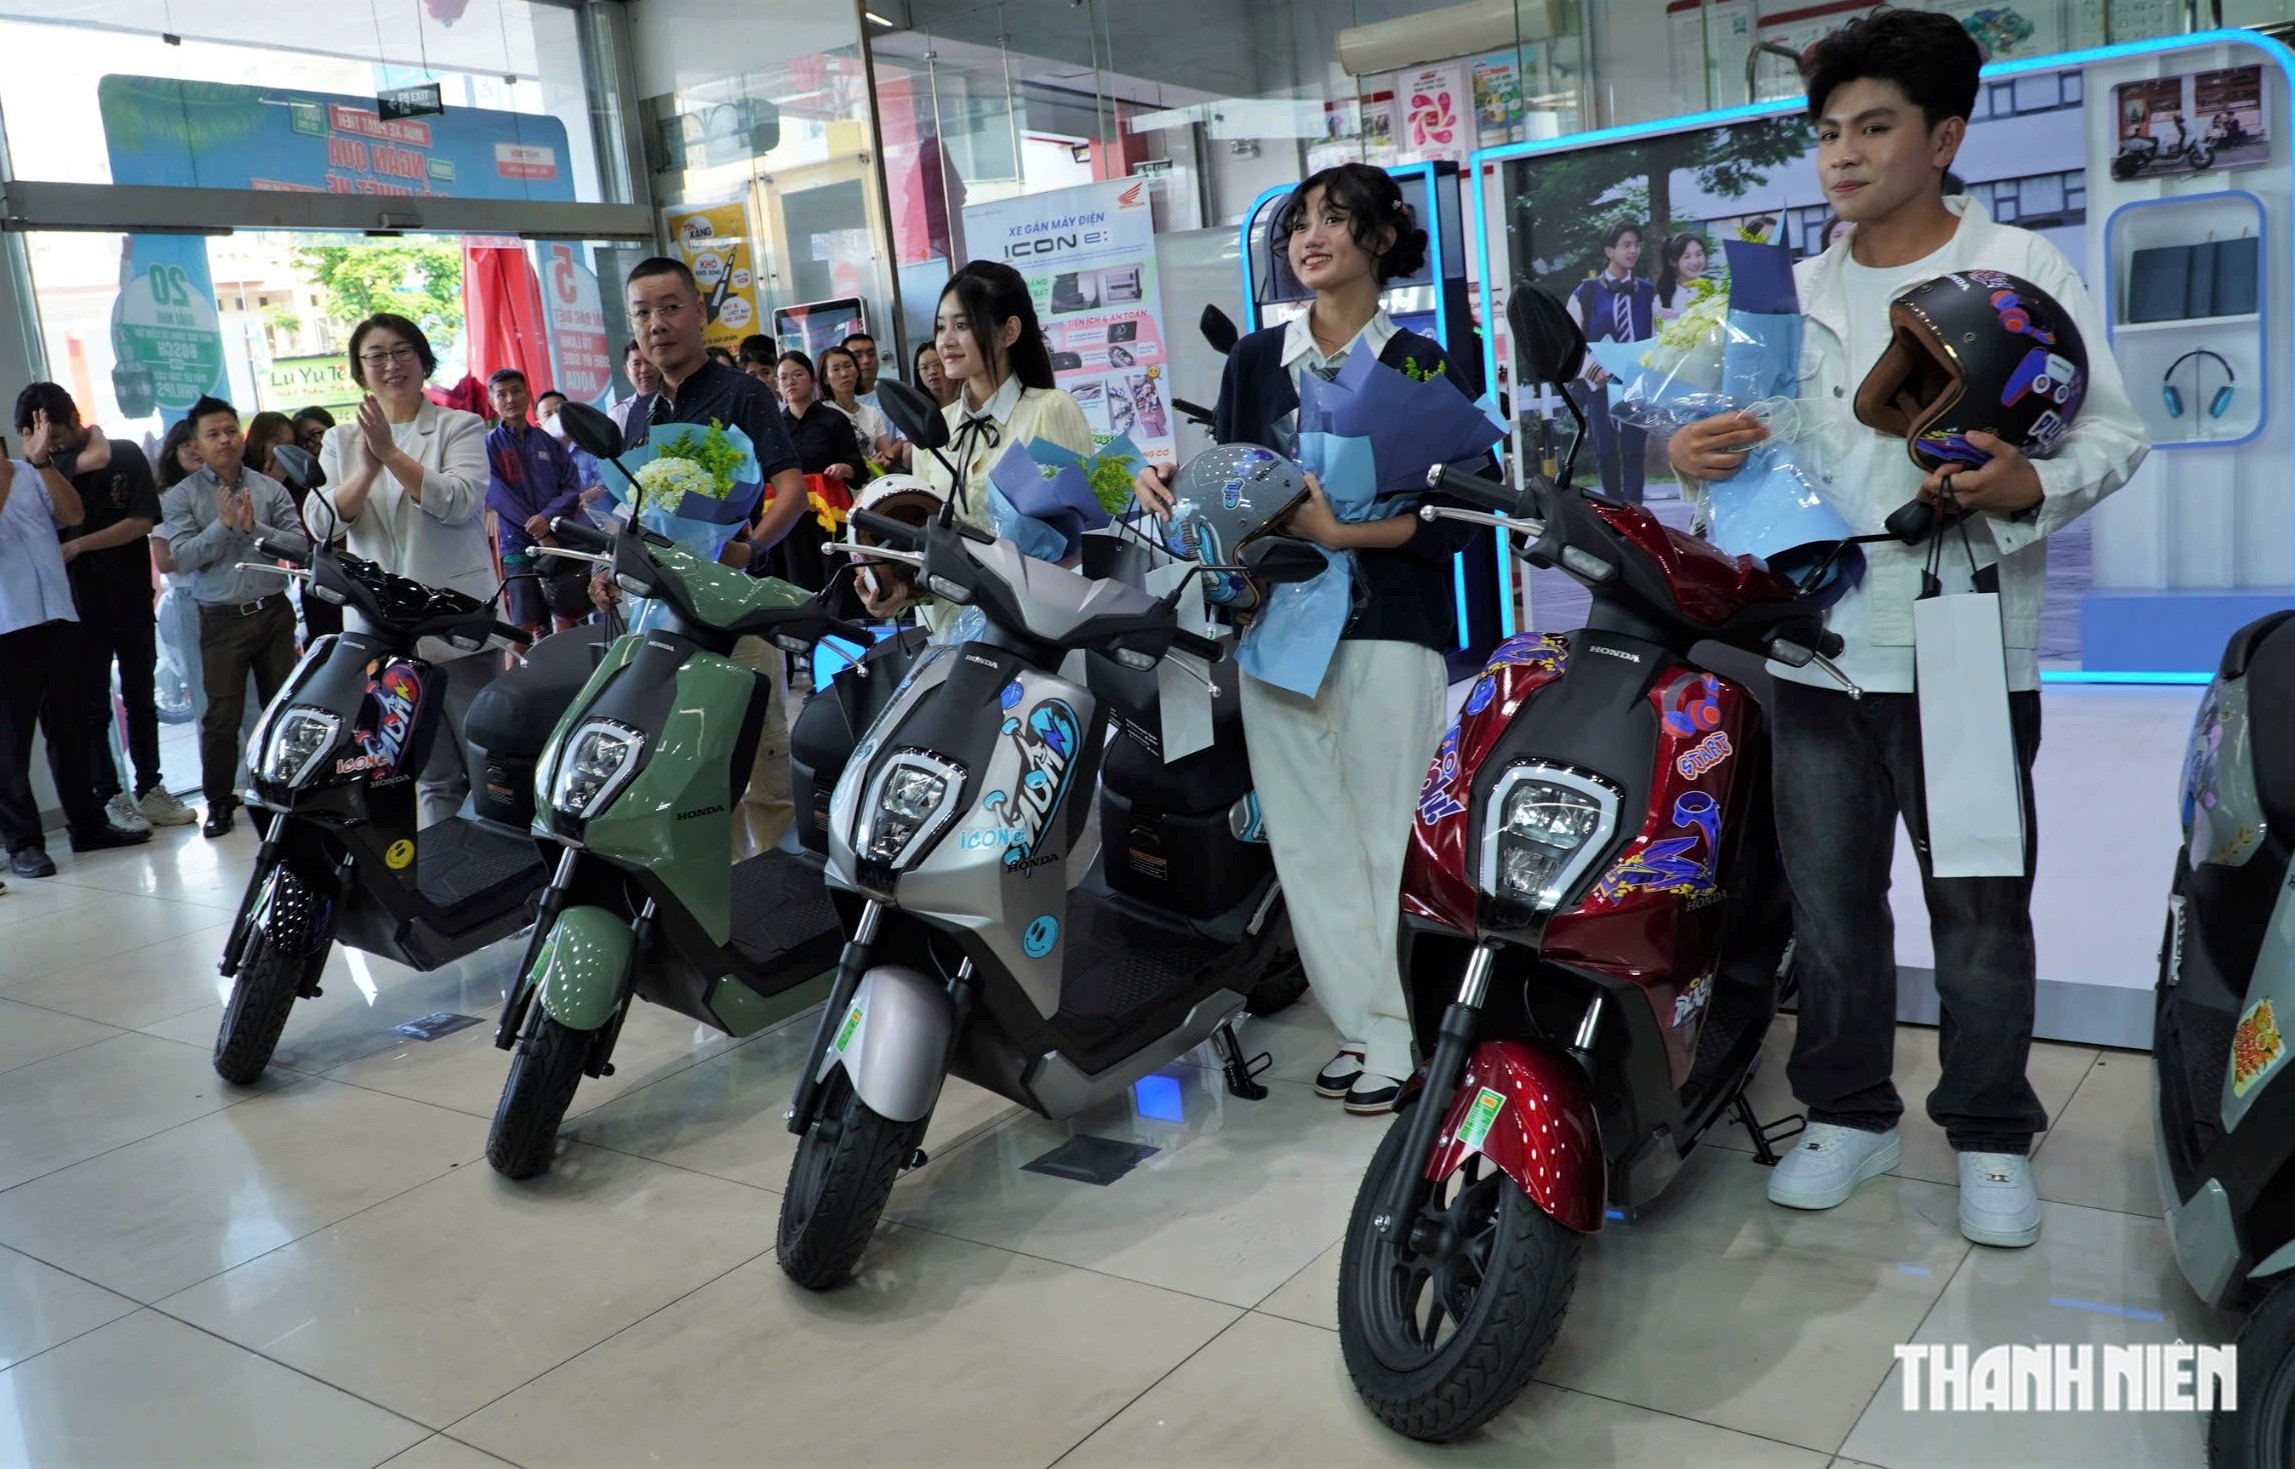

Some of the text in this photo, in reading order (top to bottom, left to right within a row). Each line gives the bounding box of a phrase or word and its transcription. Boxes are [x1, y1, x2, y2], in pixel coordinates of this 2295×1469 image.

[1008, 226, 1022, 237] XE
[1051, 215, 1077, 230] MÁY
[1078, 212, 1105, 226] ĐIỆN
[1004, 234, 1077, 258] ICON
[965, 654, 998, 669] HONDA
[1589, 645, 1641, 664] HONDA
[1679, 732, 1732, 778] START
[370, 774, 412, 789] HONDA
[676, 804, 725, 821] HONDA
[1007, 853, 1060, 873] HONDA
[1685, 889, 1729, 912] HONDA
